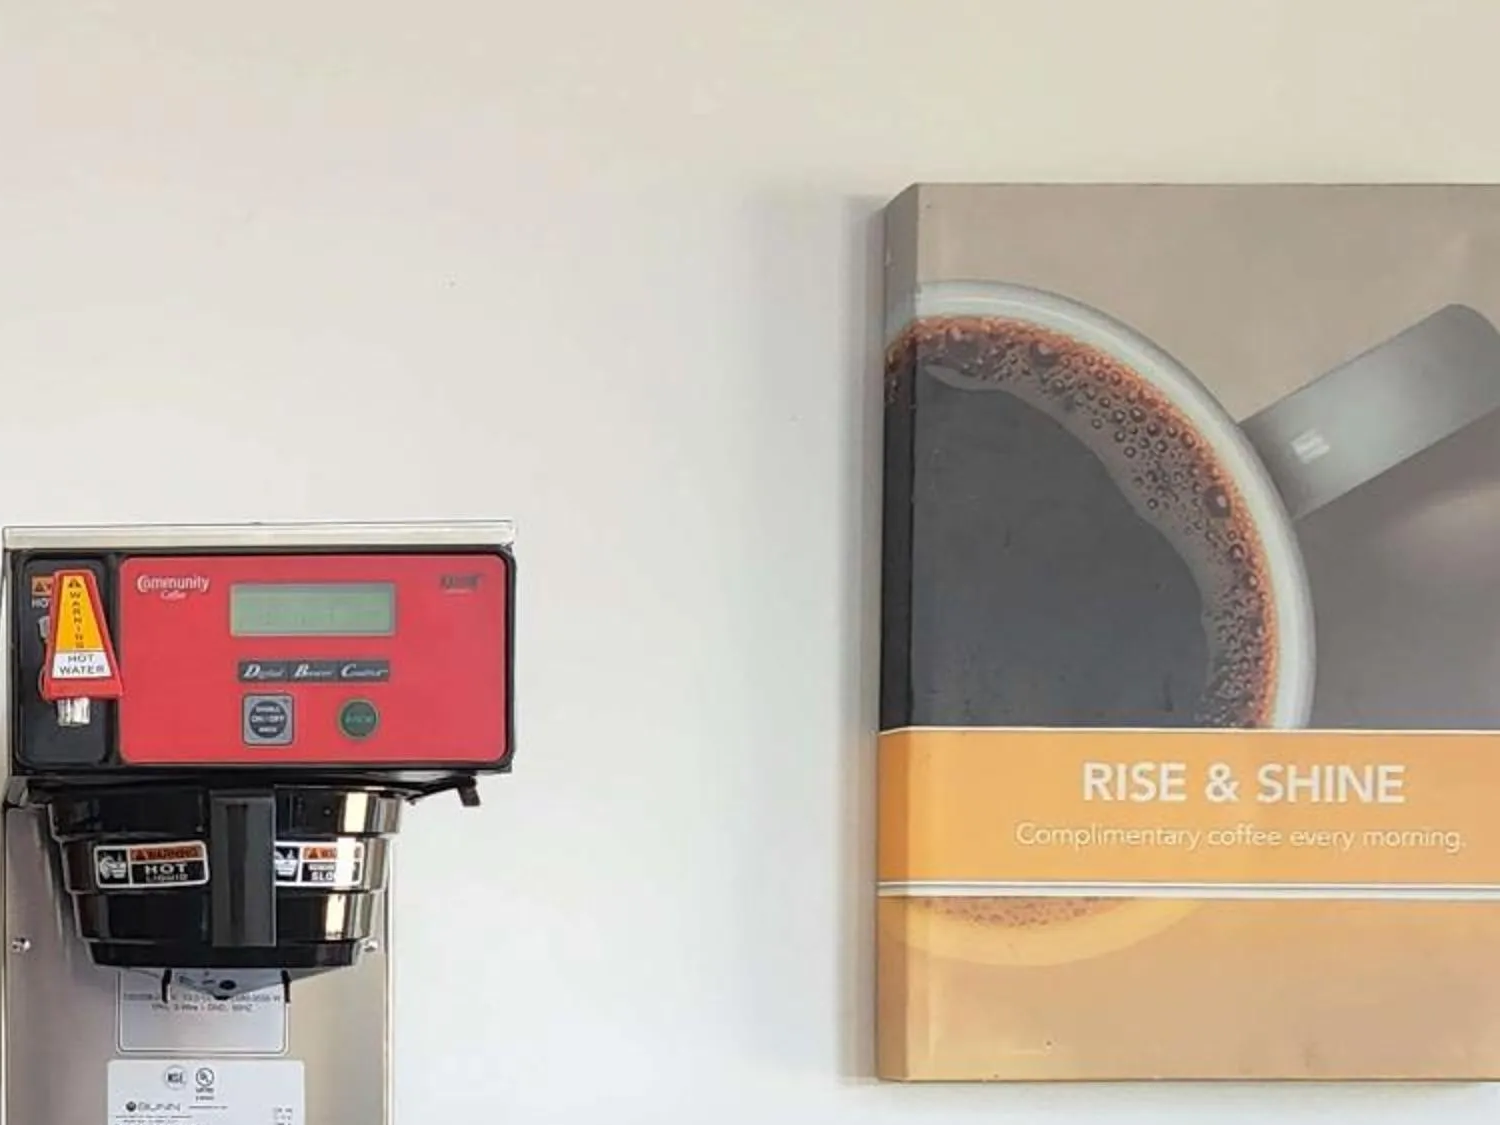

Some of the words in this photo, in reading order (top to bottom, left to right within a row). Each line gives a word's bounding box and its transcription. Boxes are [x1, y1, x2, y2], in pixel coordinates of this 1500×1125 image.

[136, 574, 210, 593] Community
[59, 665, 105, 675] WATER
[1083, 762, 1187, 802] RISE
[1205, 761, 1239, 801] &
[1256, 763, 1405, 803] SHINE
[1016, 822, 1200, 850] Complimentary
[1207, 824, 1282, 847] coffee
[1290, 831, 1355, 850] every
[1363, 828, 1467, 853] morning.
[145, 863, 187, 875] HOT
